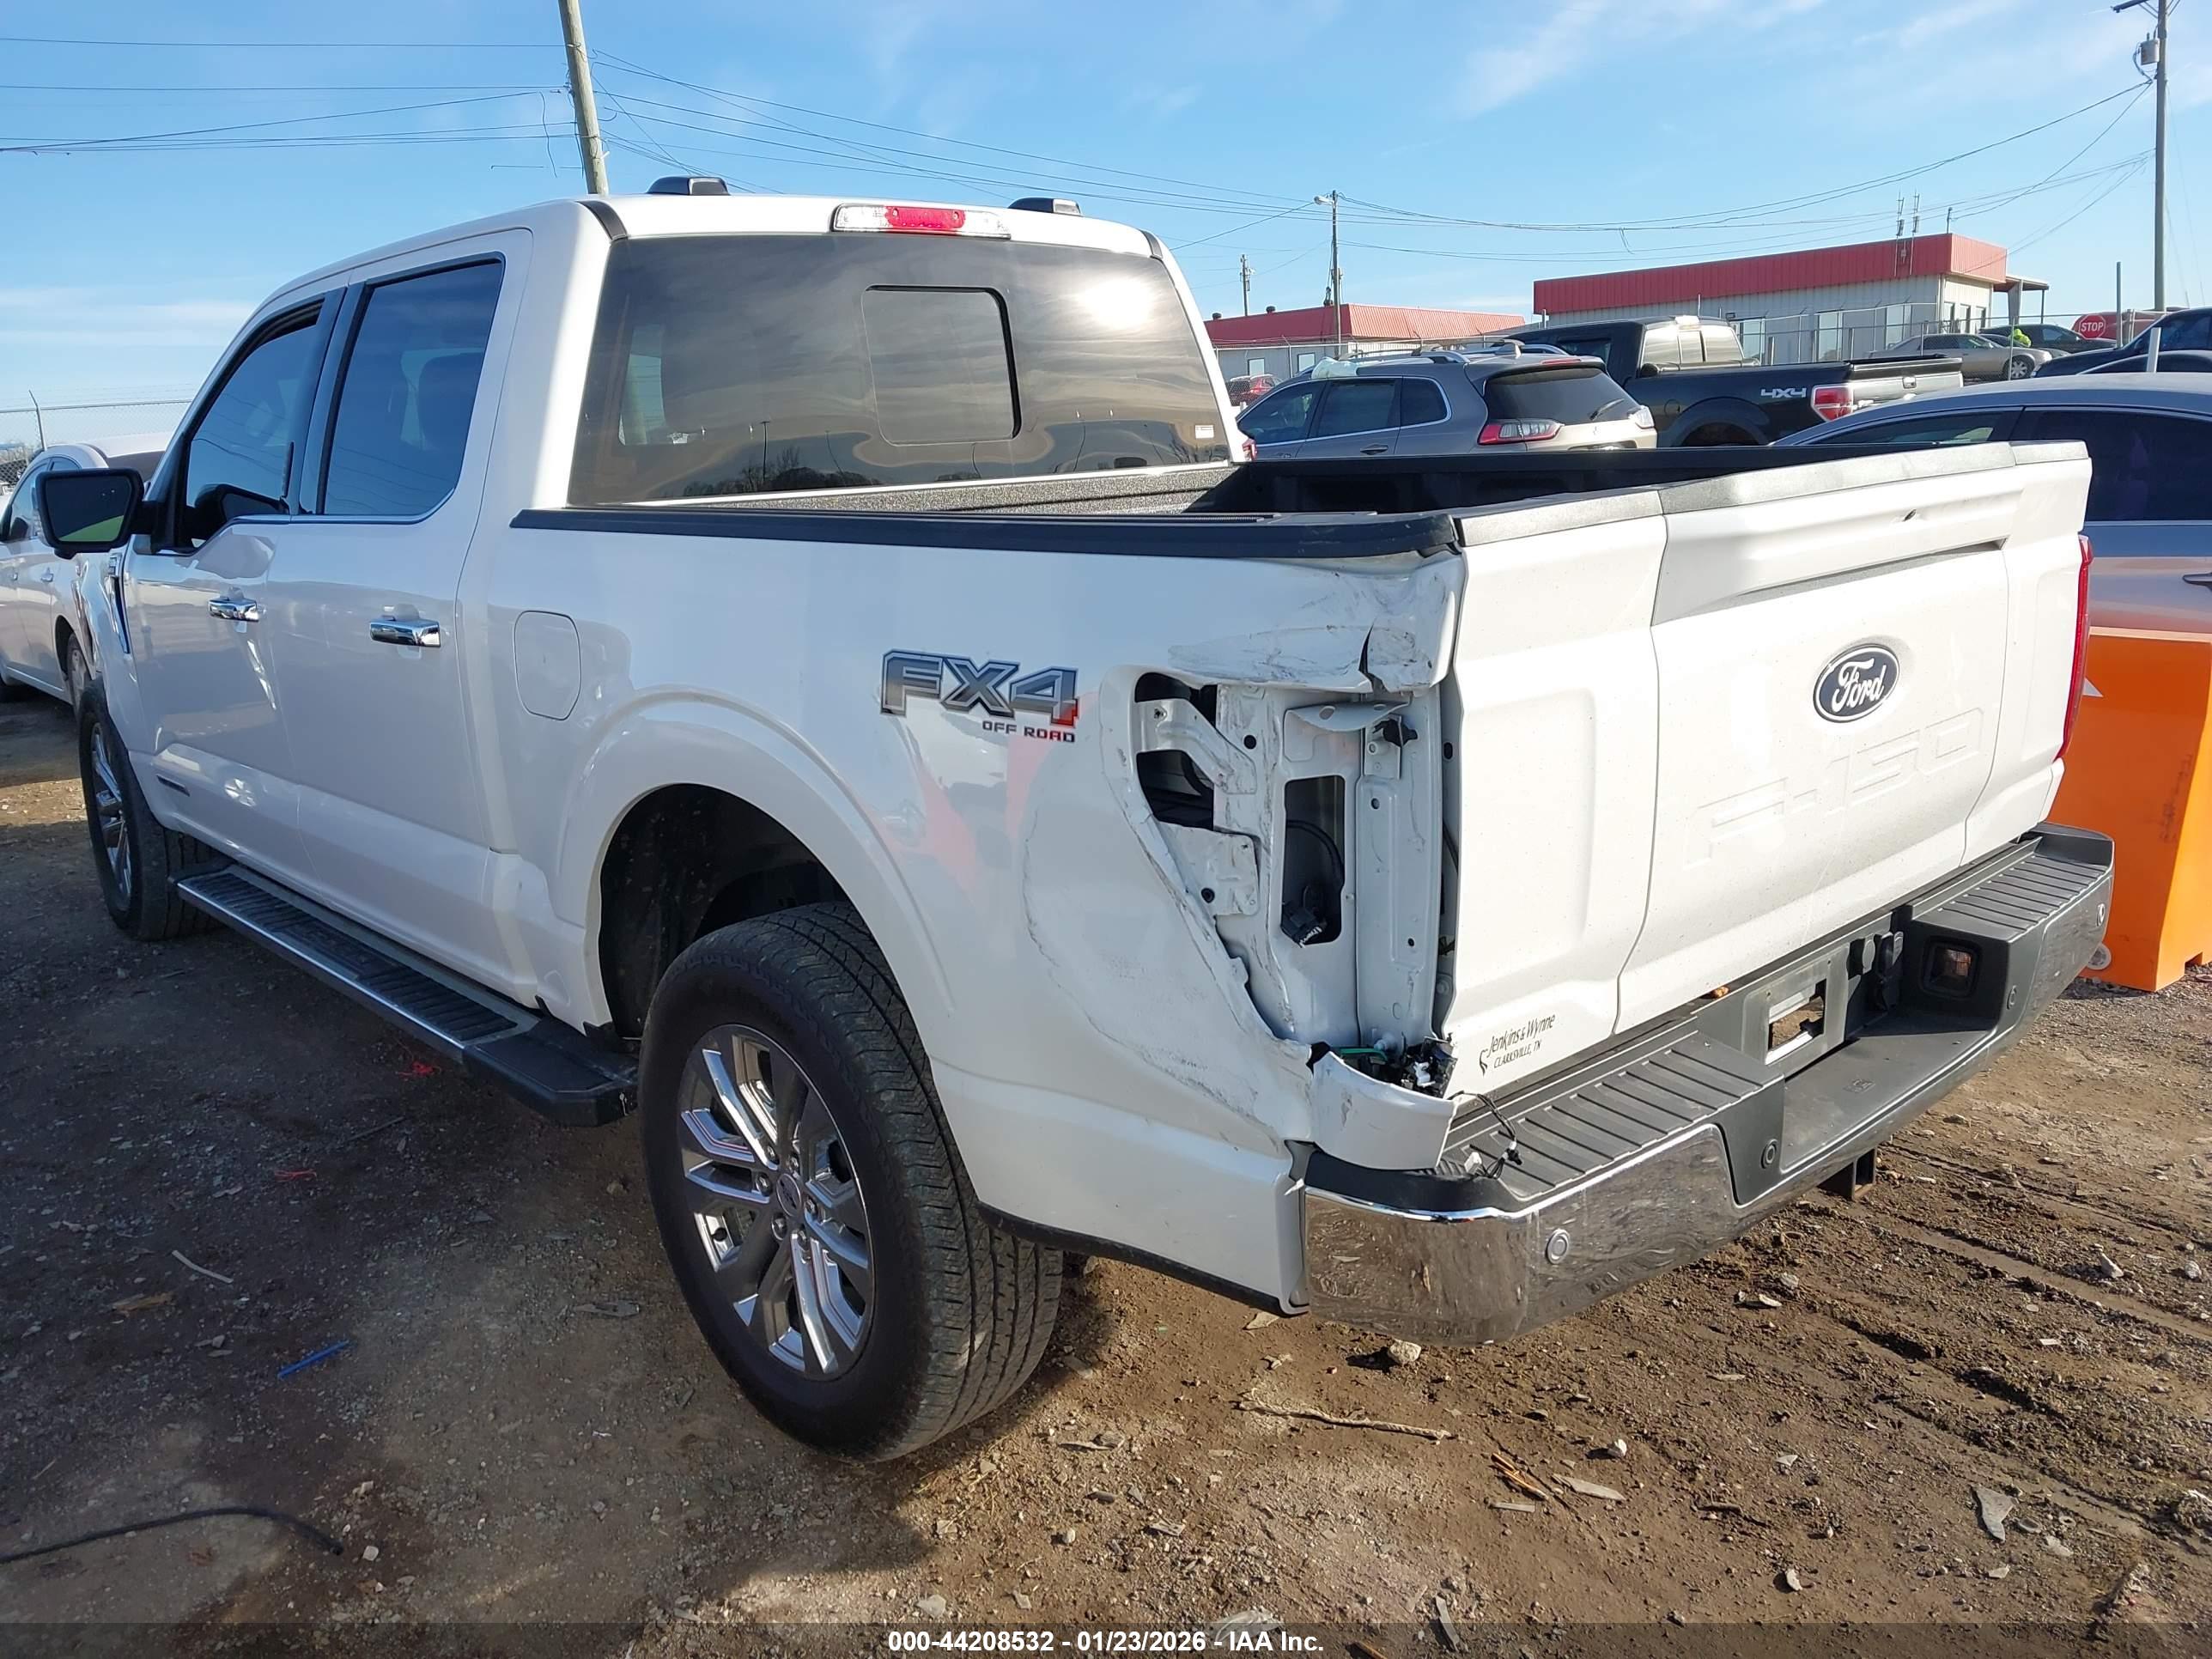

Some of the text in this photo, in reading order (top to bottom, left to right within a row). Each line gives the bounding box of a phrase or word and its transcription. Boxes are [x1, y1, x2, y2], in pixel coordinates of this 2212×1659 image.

[2081, 322, 2103, 331] STOP
[1761, 387, 1807, 398] 4X4
[881, 649, 1079, 726] FX4
[1831, 657, 1887, 714] Ford
[981, 720, 1075, 743] OFF ROAD
[1683, 707, 1985, 871] F-150
[1486, 1029, 1521, 1059] Jenkins
[1526, 1014, 1555, 1040] Wynne
[1494, 1039, 1542, 1068] CLARKSVILLE, TN
